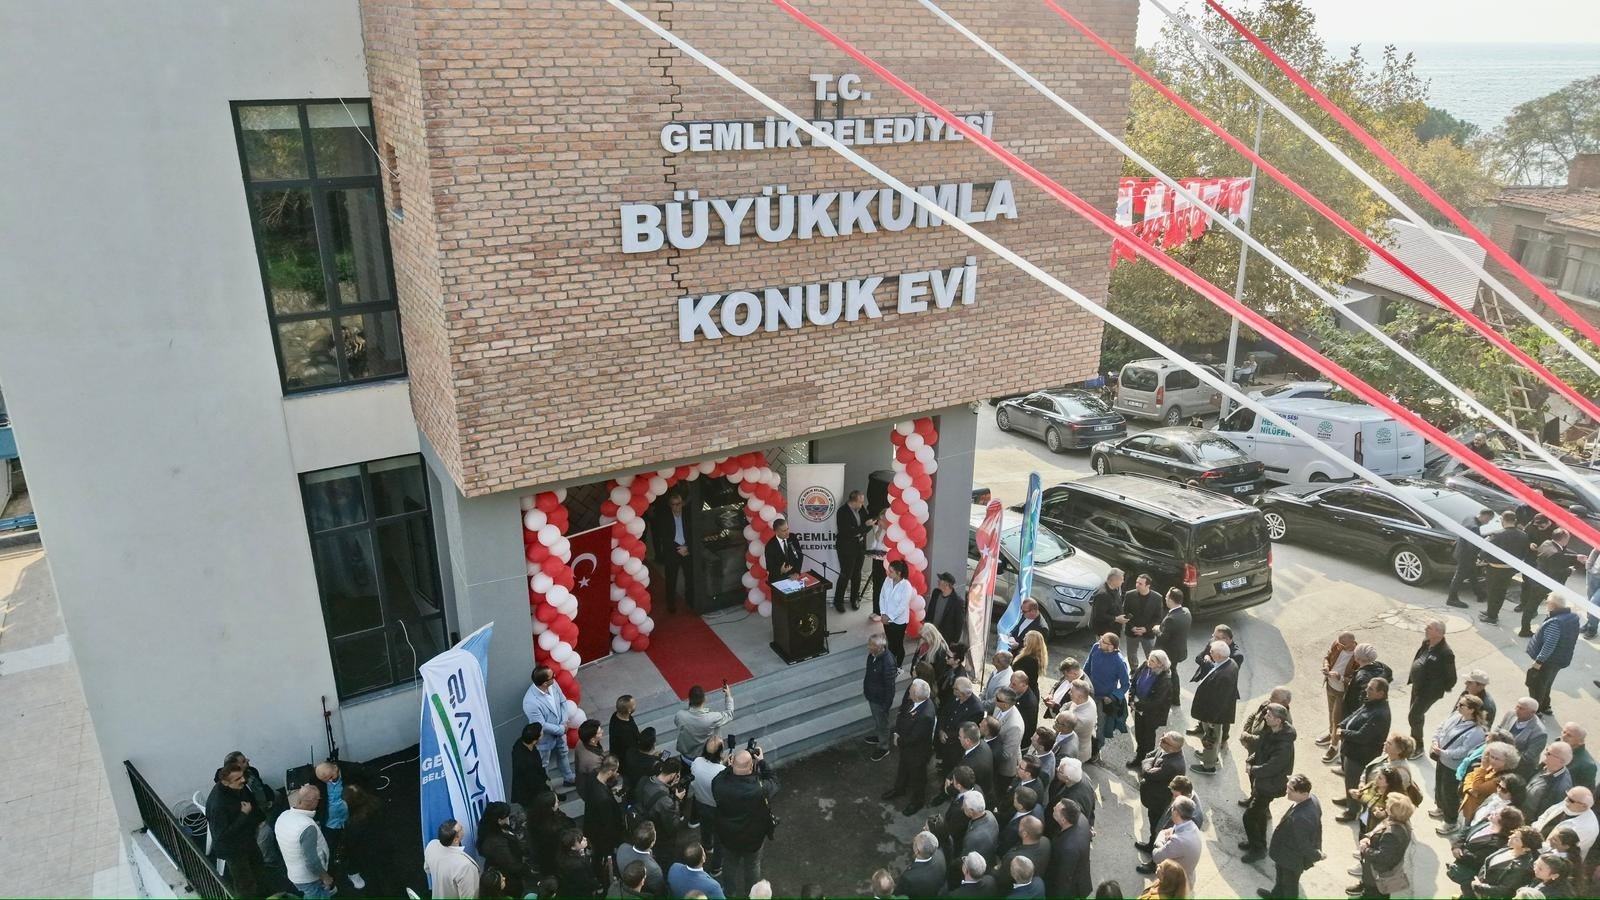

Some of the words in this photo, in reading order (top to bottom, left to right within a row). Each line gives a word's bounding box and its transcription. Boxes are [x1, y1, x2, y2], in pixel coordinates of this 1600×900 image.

[810, 73, 871, 101] T.C.
[660, 116, 802, 153] GEMLİK
[811, 111, 993, 147] BELEDİYESİ
[620, 179, 1019, 254] BÜYÜKKUMLA
[678, 276, 883, 342] KONUK
[897, 255, 978, 314] EVİ
[422, 755, 442, 771] GE
